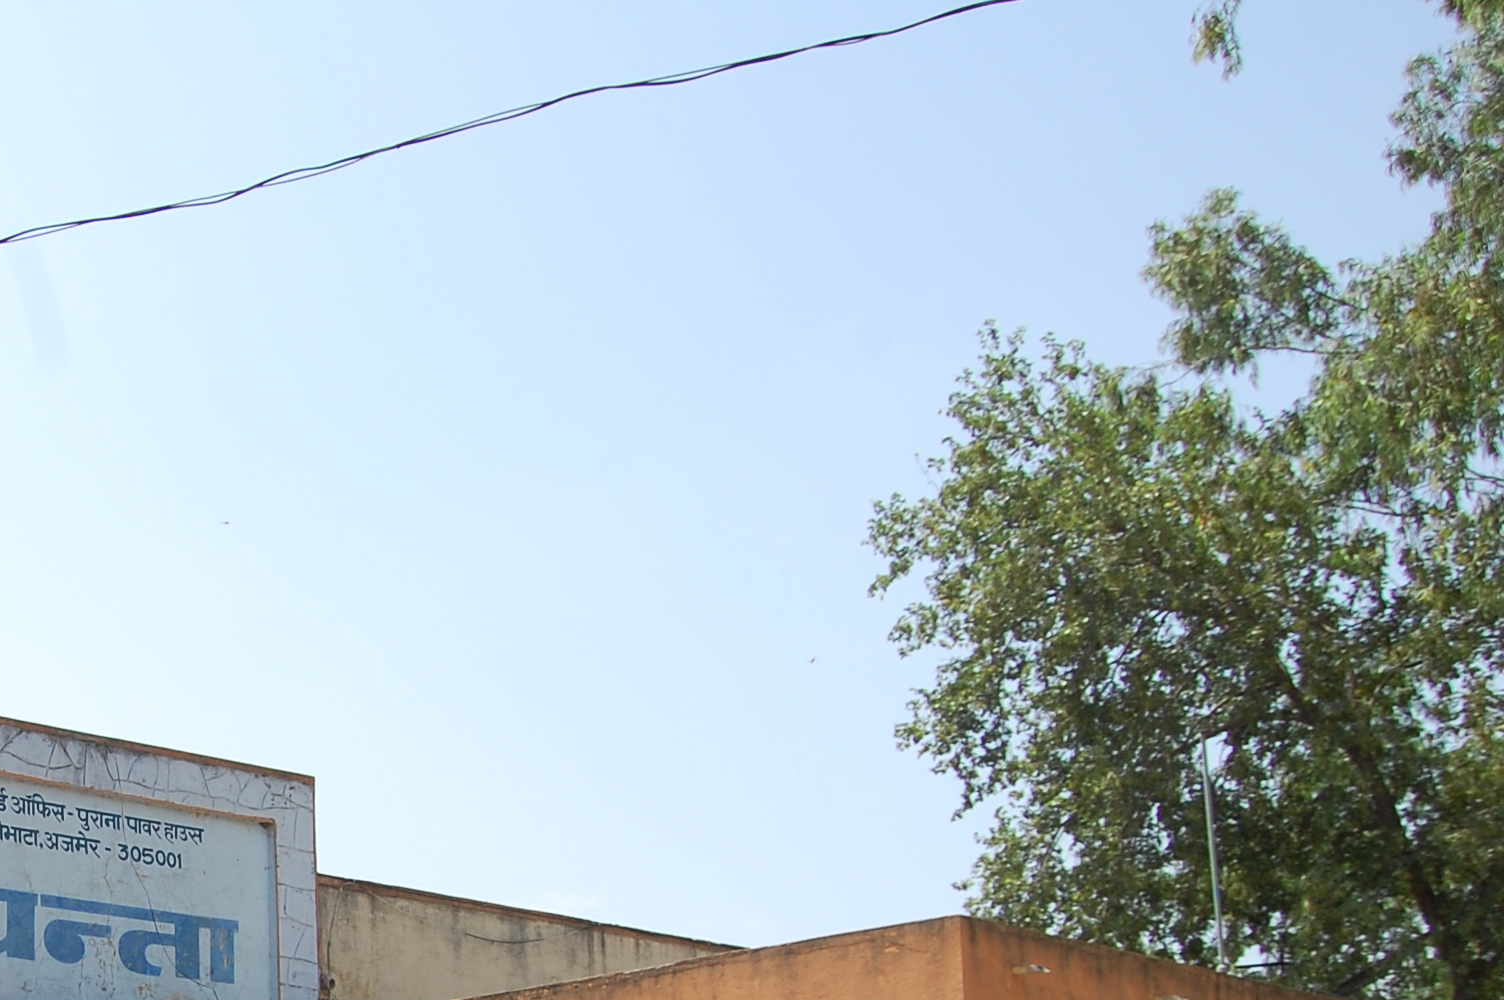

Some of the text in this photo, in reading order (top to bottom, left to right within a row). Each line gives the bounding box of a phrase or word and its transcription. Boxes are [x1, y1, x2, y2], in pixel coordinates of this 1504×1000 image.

[124, 815, 162, 840] पावर
[164, 822, 205, 846] हाउस
[117, 843, 183, 869] 305001
